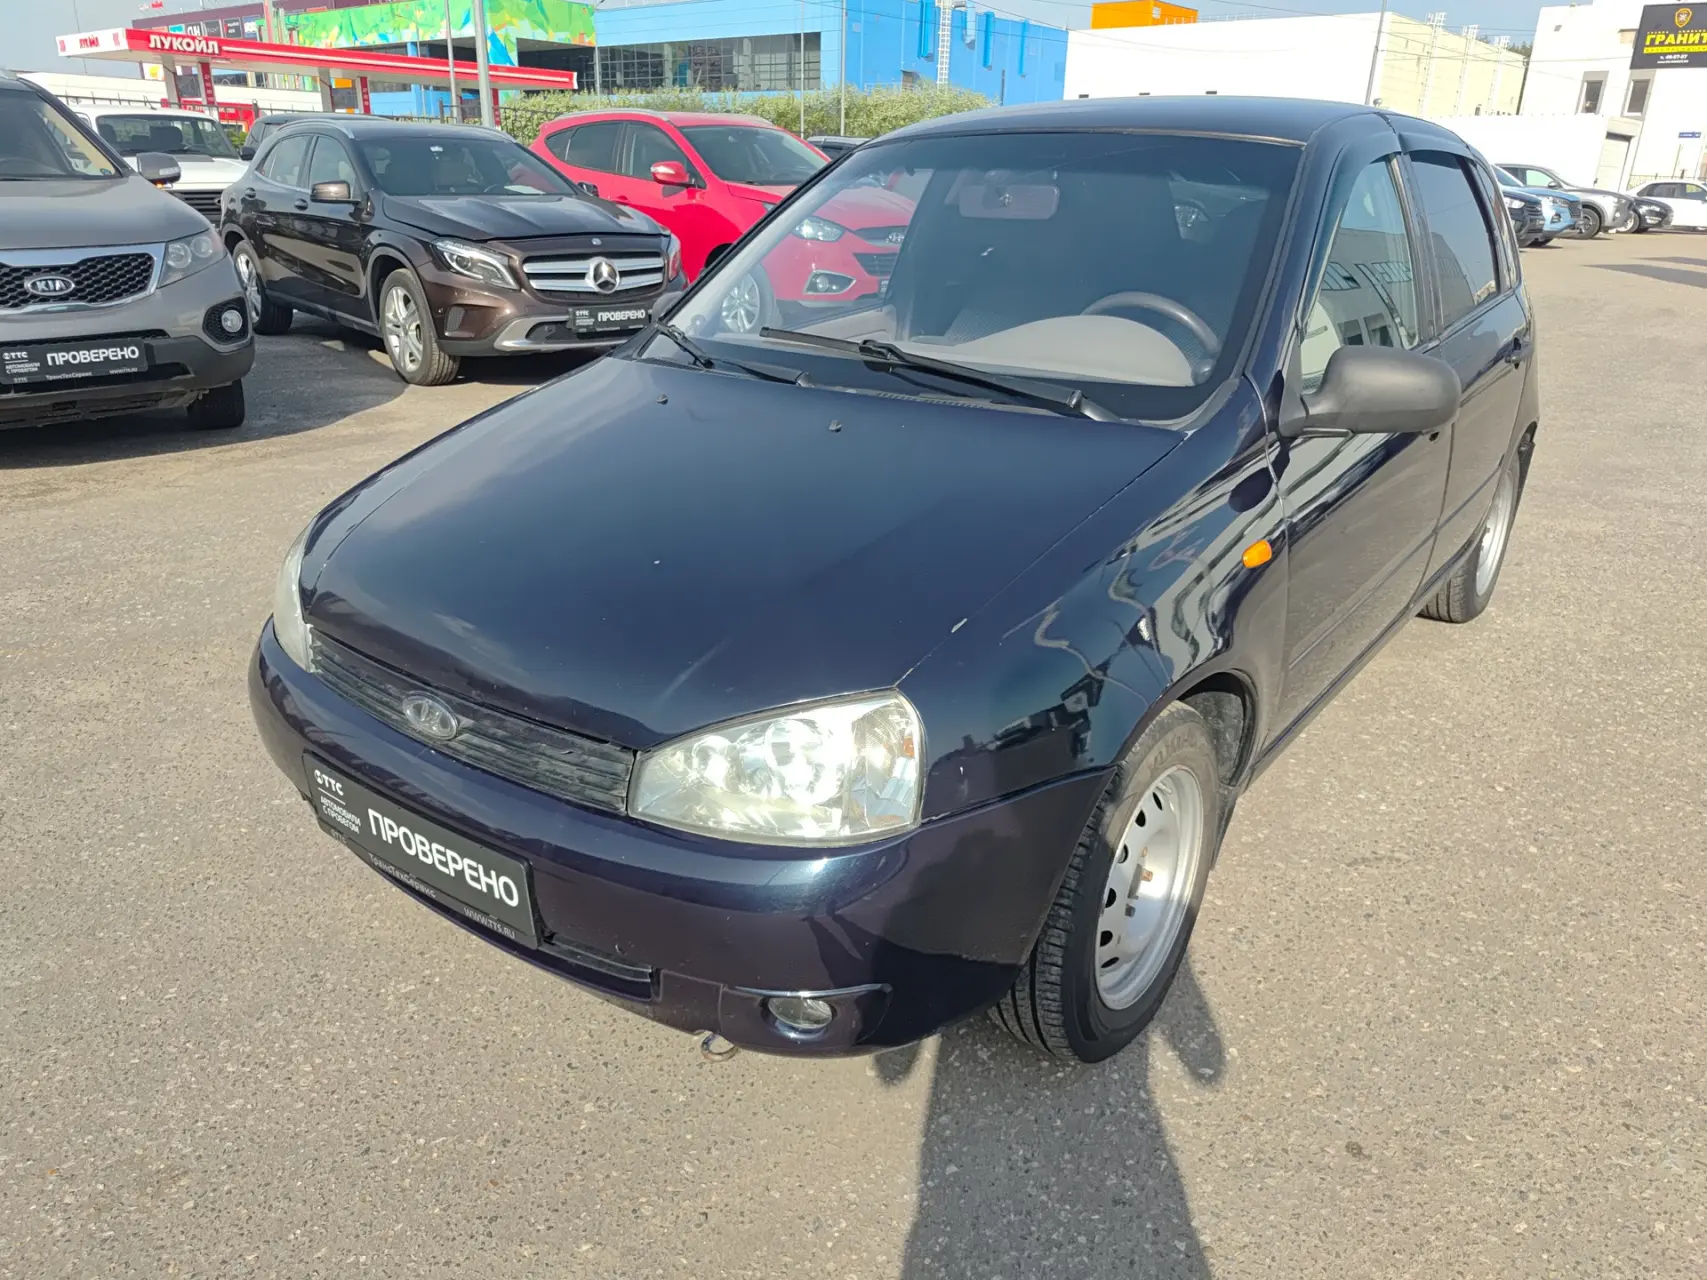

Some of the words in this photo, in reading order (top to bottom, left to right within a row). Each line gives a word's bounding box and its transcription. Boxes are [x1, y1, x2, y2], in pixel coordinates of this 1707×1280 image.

[150, 34, 219, 54] ЛУКОЙЛ
[1645, 32, 1707, 45] ГРАНИТ
[36, 279, 67, 291] KIA
[597, 309, 646, 322] ПРОВЕРЕНО
[46, 346, 139, 366] ПРОВЕРЕНО
[321, 773, 344, 796] ТТС
[320, 795, 361, 826] АВТОМОБИЛИ
[322, 804, 328, 814] С
[327, 807, 360, 835] ПРОБЕГОМ
[367, 808, 519, 908] ПРОВЕРЕНО
[368, 852, 437, 899] ТрансТехСервис
